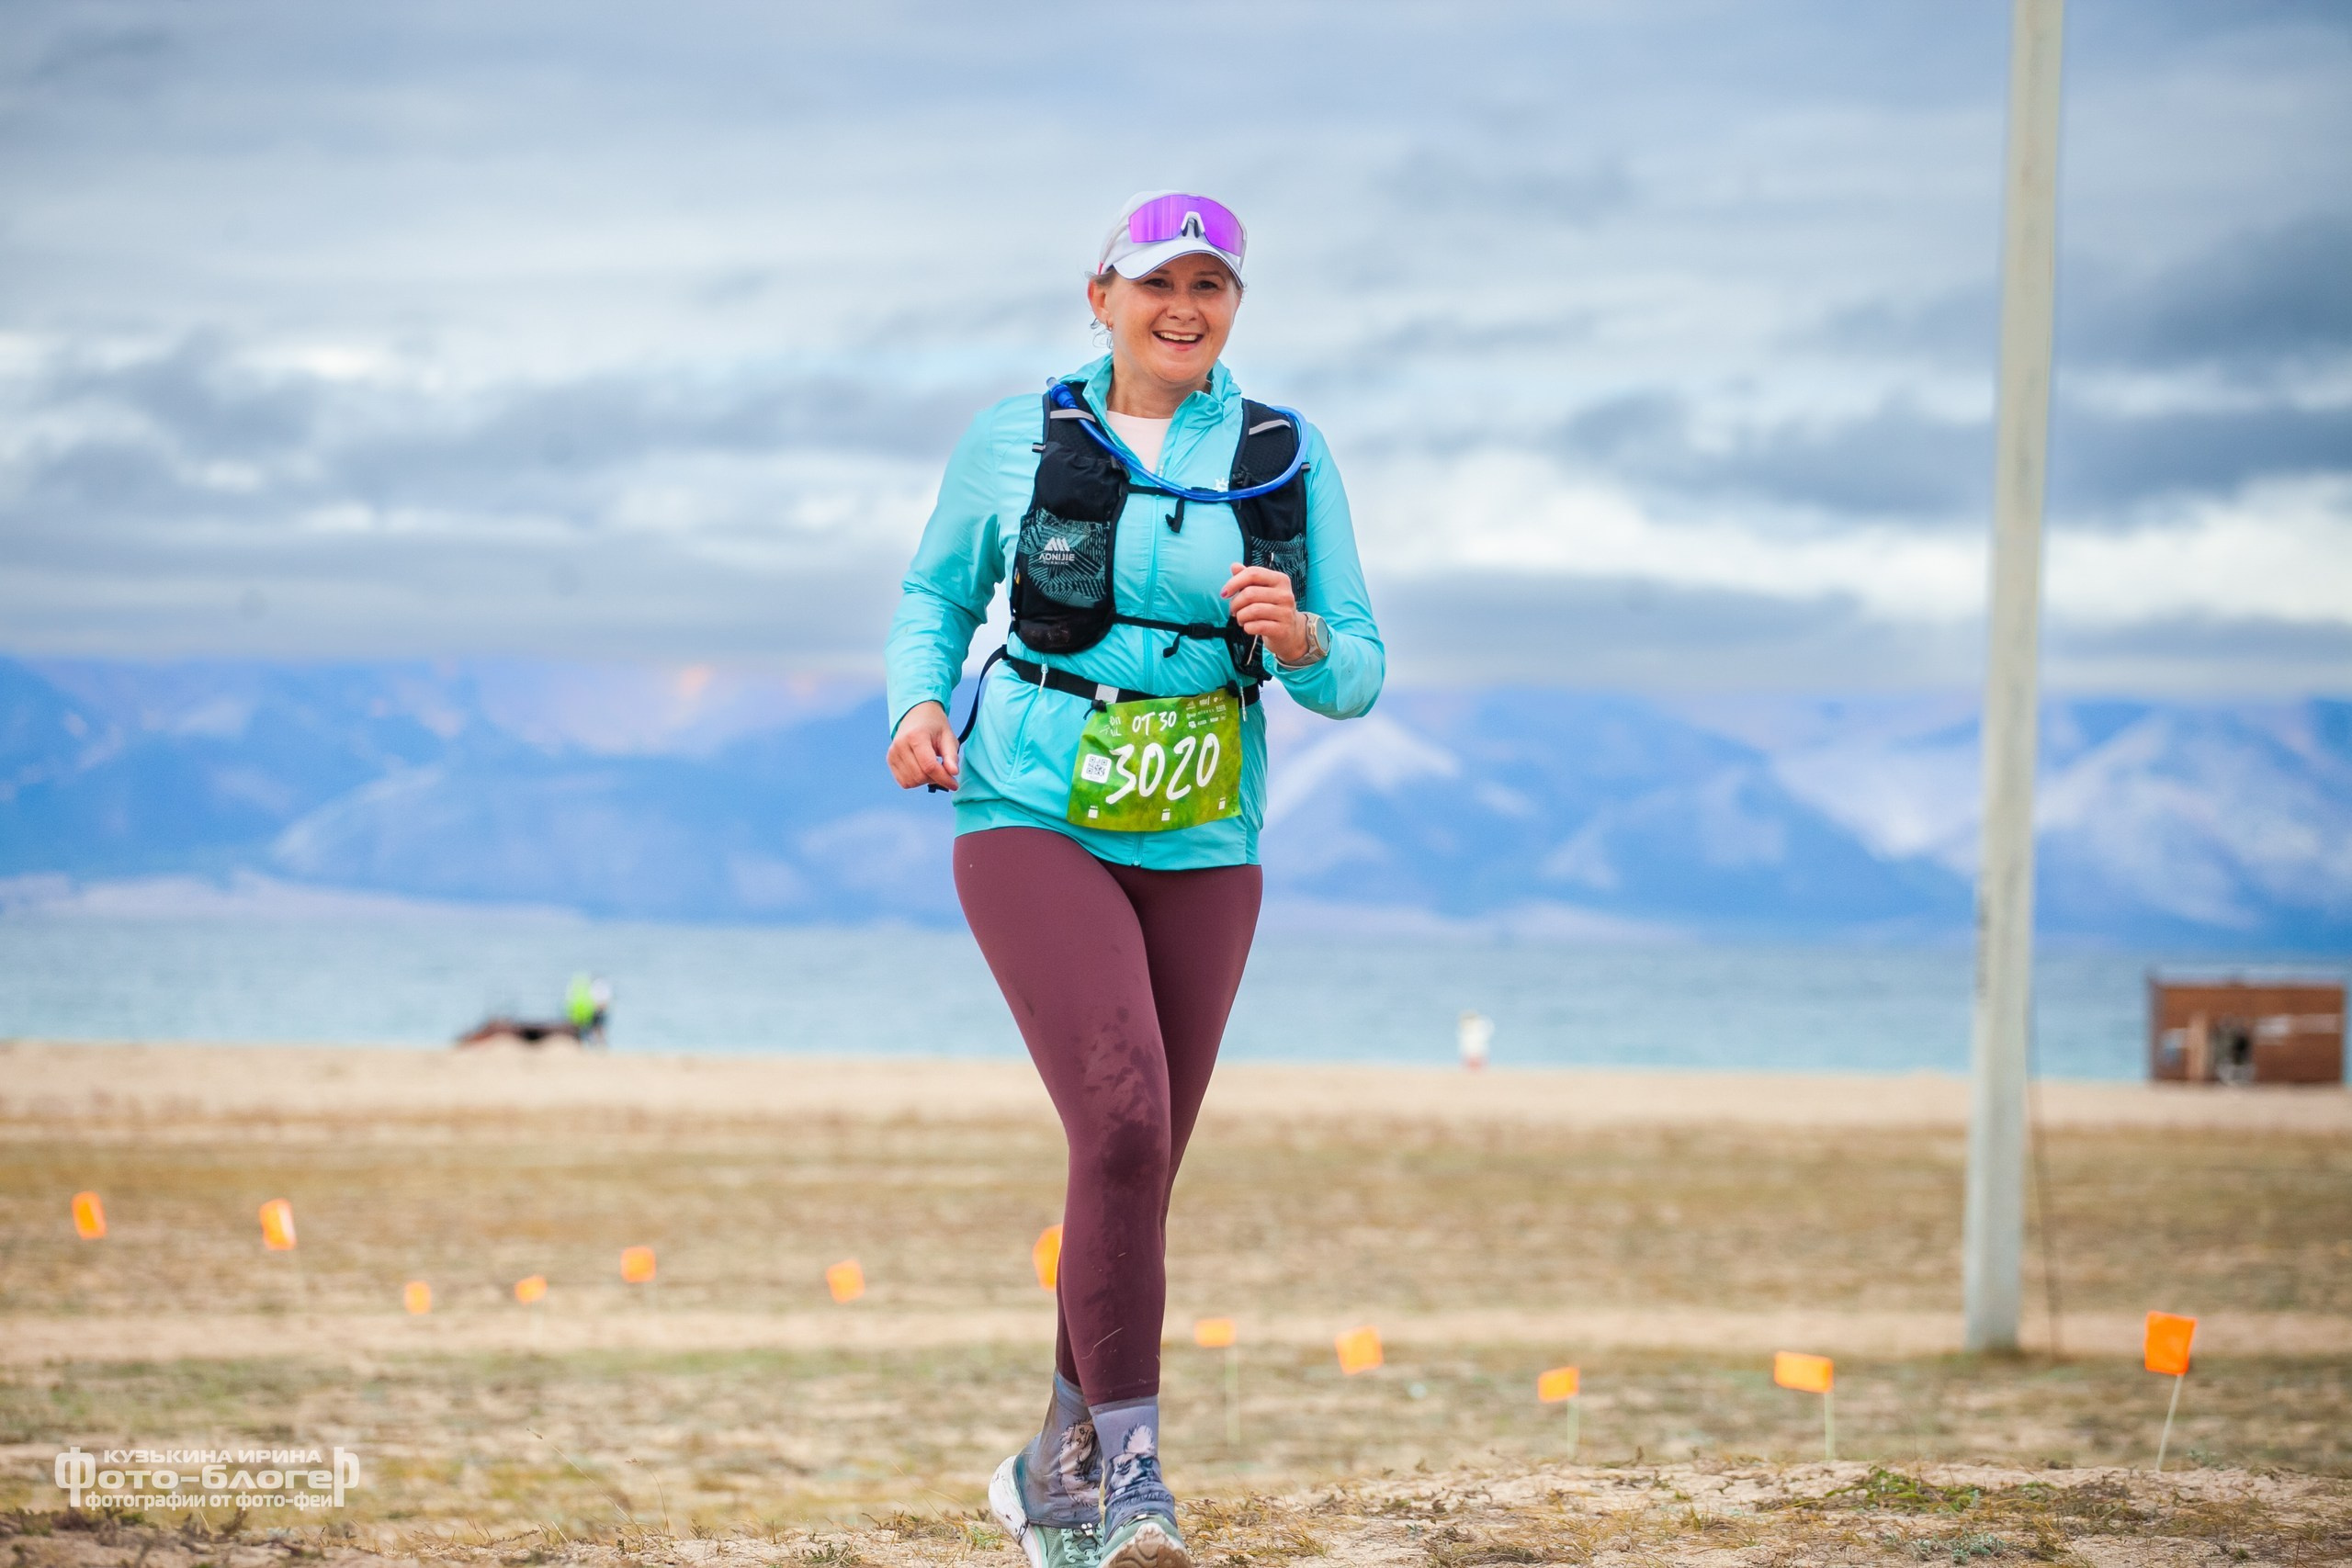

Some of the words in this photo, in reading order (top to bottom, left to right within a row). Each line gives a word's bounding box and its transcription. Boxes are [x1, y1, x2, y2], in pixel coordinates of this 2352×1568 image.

[1038, 553, 1075, 561] AONIJIE
[1132, 711, 1156, 736] OT
[1159, 711, 1177, 731] 30
[1105, 732, 1220, 805] 3020
